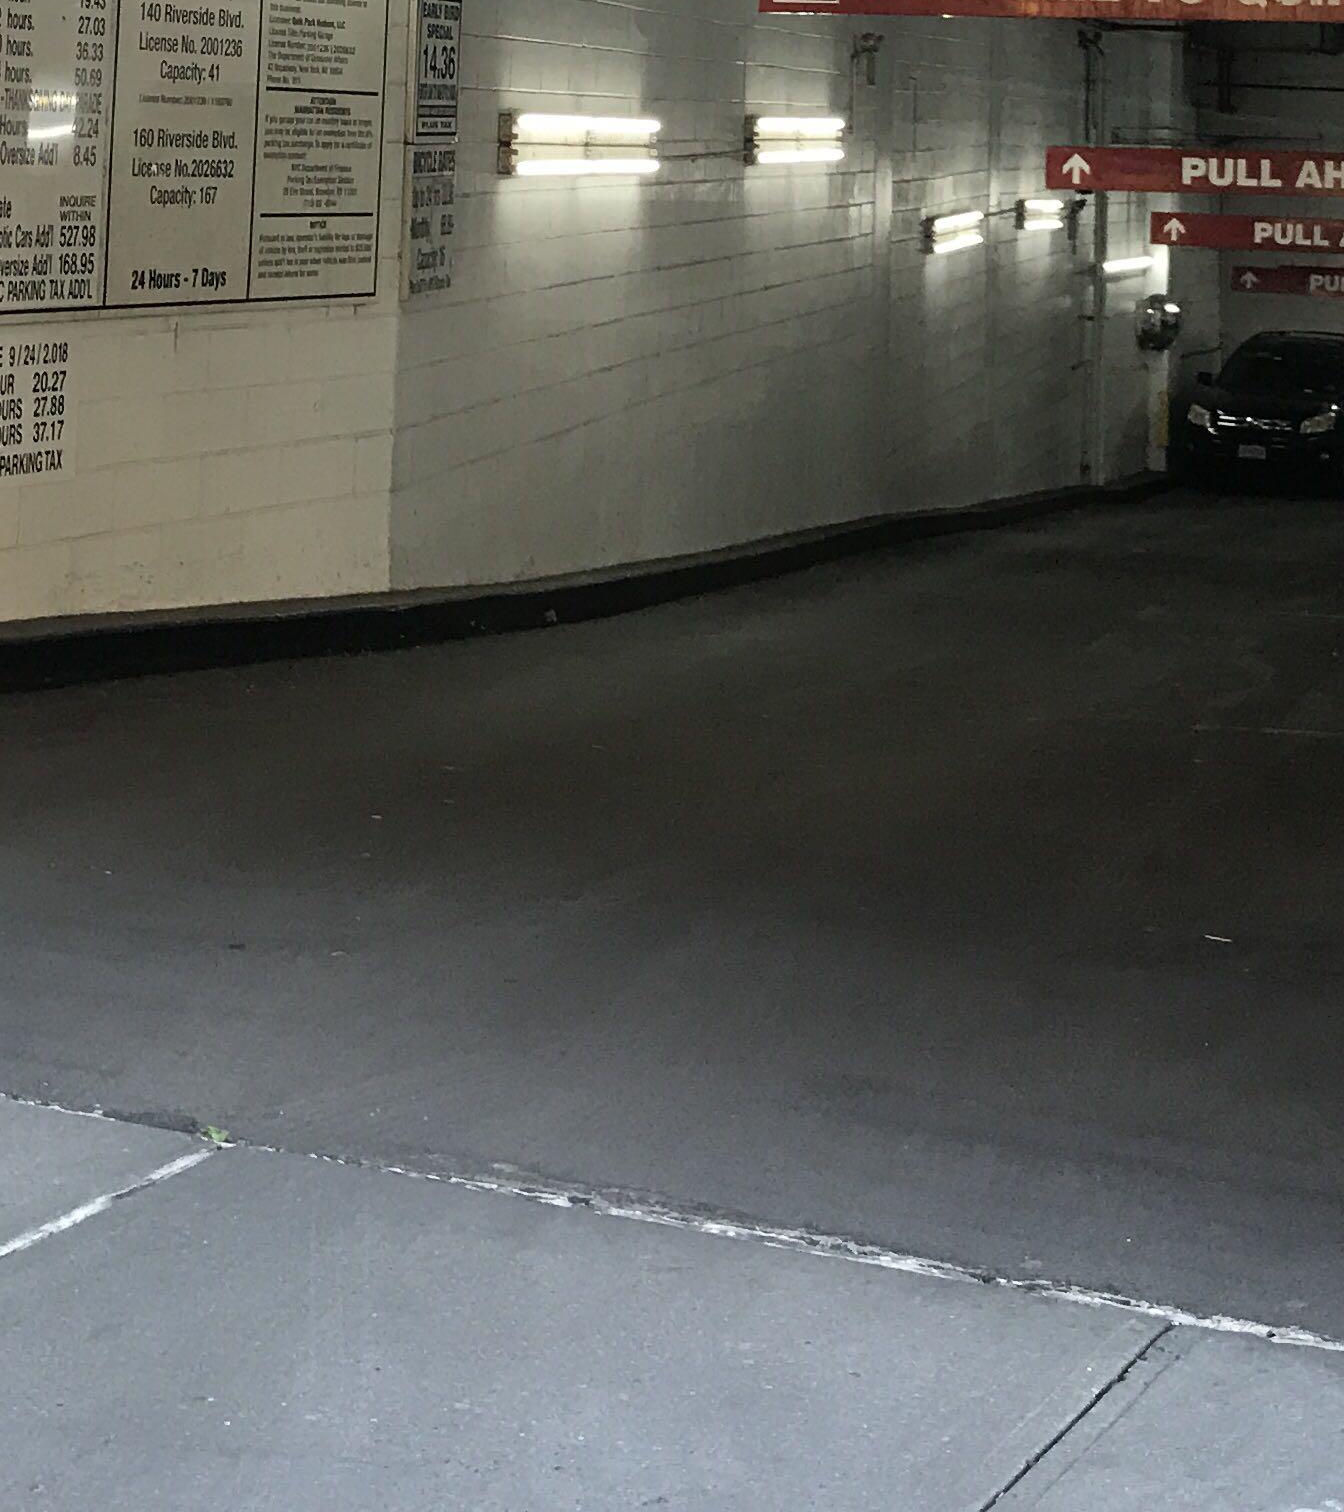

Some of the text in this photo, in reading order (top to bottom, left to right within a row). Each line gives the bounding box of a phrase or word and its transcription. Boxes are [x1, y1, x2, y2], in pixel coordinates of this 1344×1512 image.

[78, 15, 106, 36] 27.03
[141, 2, 244, 29] 140 Riverside Blvd.
[139, 31, 178, 53] License
[181, 34, 197, 54] No.
[200, 36, 243, 57] 2001236
[160, 59, 220, 85] Capacity: 41
[424, 44, 456, 80] 14.36
[133, 128, 238, 150] 160 Riverside Blvd.
[73, 145, 97, 167] 8.45
[132, 158, 171, 177] License
[1182, 157, 1282, 187] PULL
[59, 195, 97, 208] INQUIRE
[150, 185, 218, 208] Capacity: 167
[60, 210, 91, 222] WITHIN
[15, 224, 33, 249] Cars
[59, 225, 96, 247] 527.98
[1254, 221, 1329, 246] PULL
[58, 253, 94, 275] 168.95
[131, 267, 227, 290] 24 Hours 7 Days
[7, 279, 46, 302] PARKING
[49, 279, 65, 300] TAX
[32, 370, 67, 393] 20.27
[33, 394, 65, 418] 27.88
[33, 419, 64, 443] 37.17
[0, 451, 43, 477] PARKING
[45, 449, 63, 471] TAX
